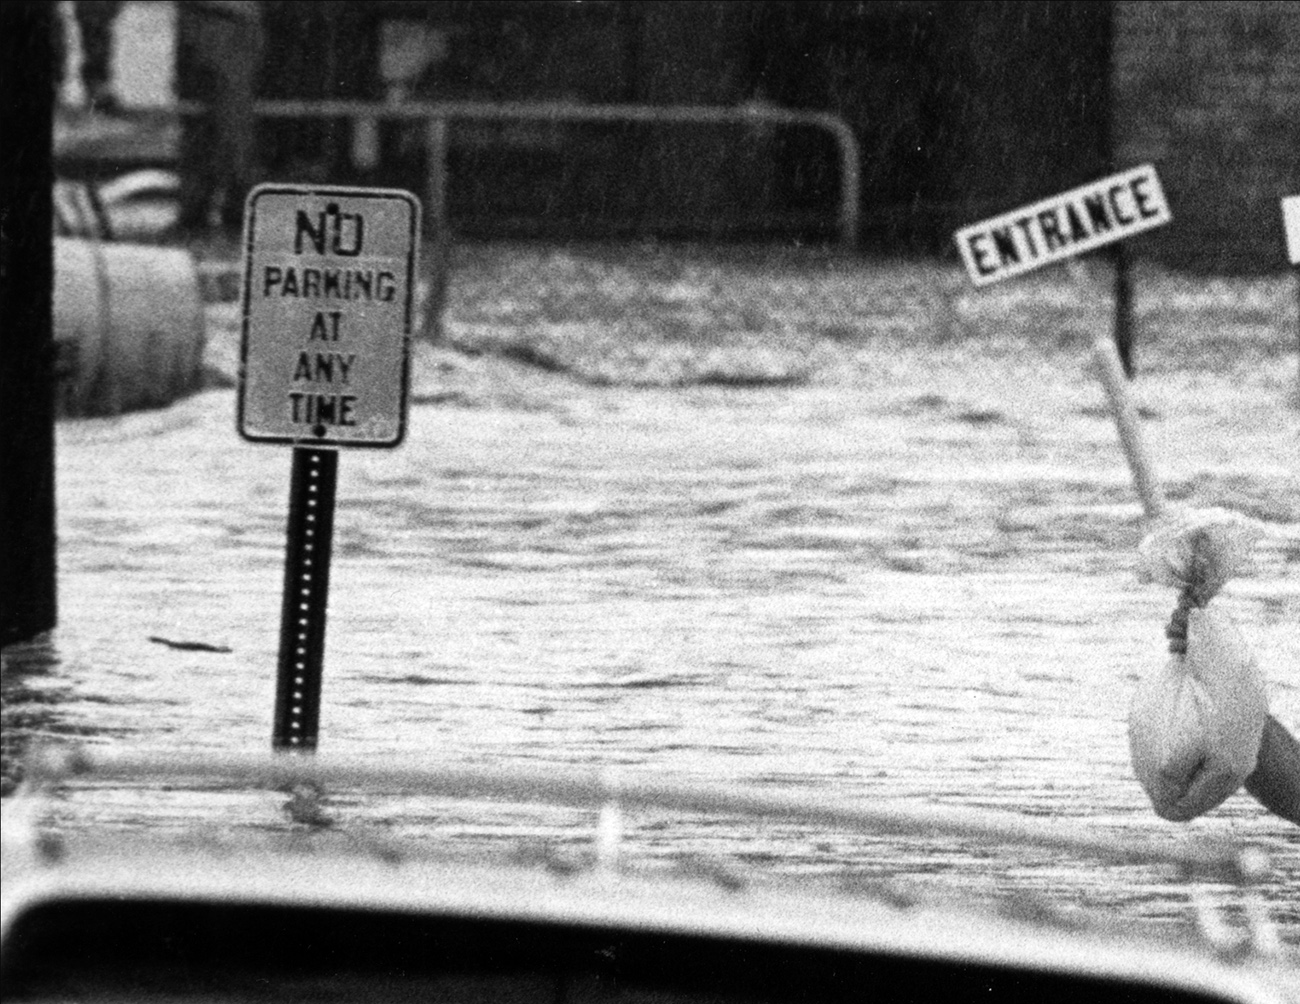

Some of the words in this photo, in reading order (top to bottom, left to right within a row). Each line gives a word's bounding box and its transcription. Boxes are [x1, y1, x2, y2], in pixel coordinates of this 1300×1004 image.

[294, 208, 364, 257] NO
[966, 175, 1159, 278] ENTRANCE
[263, 266, 396, 302] PARKING
[310, 311, 342, 342] AT
[292, 351, 357, 384] ANY
[289, 392, 359, 427] TIME
